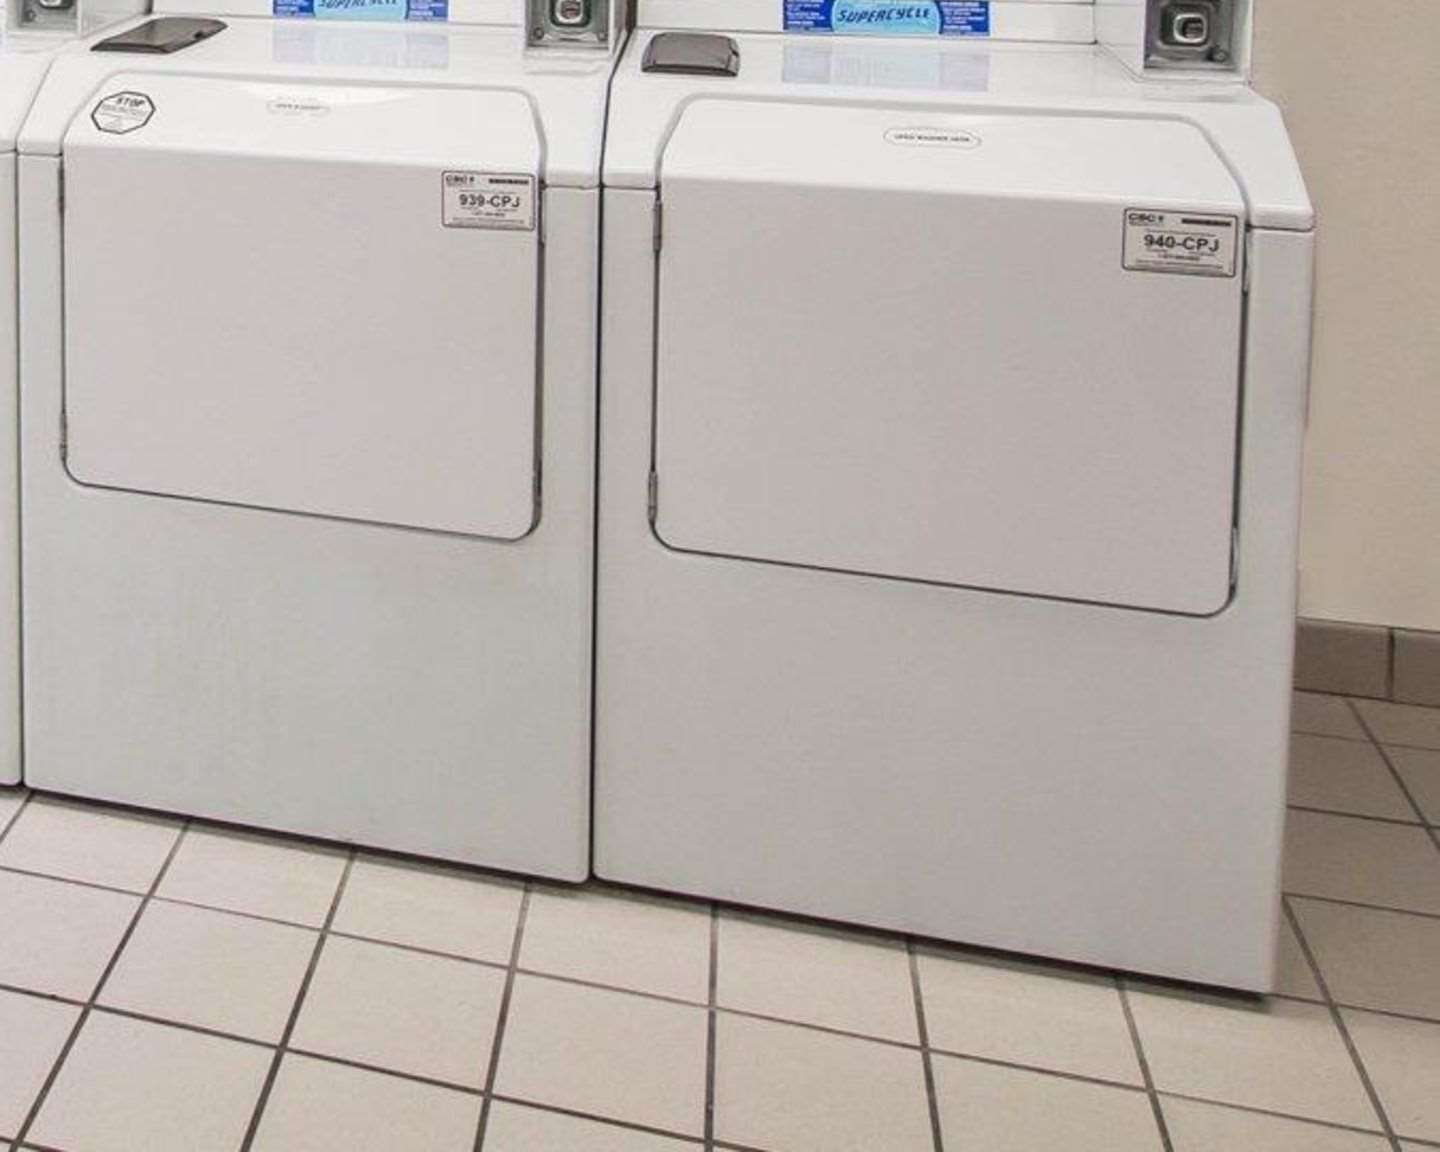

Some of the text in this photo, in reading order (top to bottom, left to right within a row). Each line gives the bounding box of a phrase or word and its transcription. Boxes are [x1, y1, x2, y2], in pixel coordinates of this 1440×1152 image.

[836, 7, 931, 24] SUPERCYCLE
[458, 192, 521, 209] 939-CPJ
[1143, 233, 1221, 253] 940-CPJ
